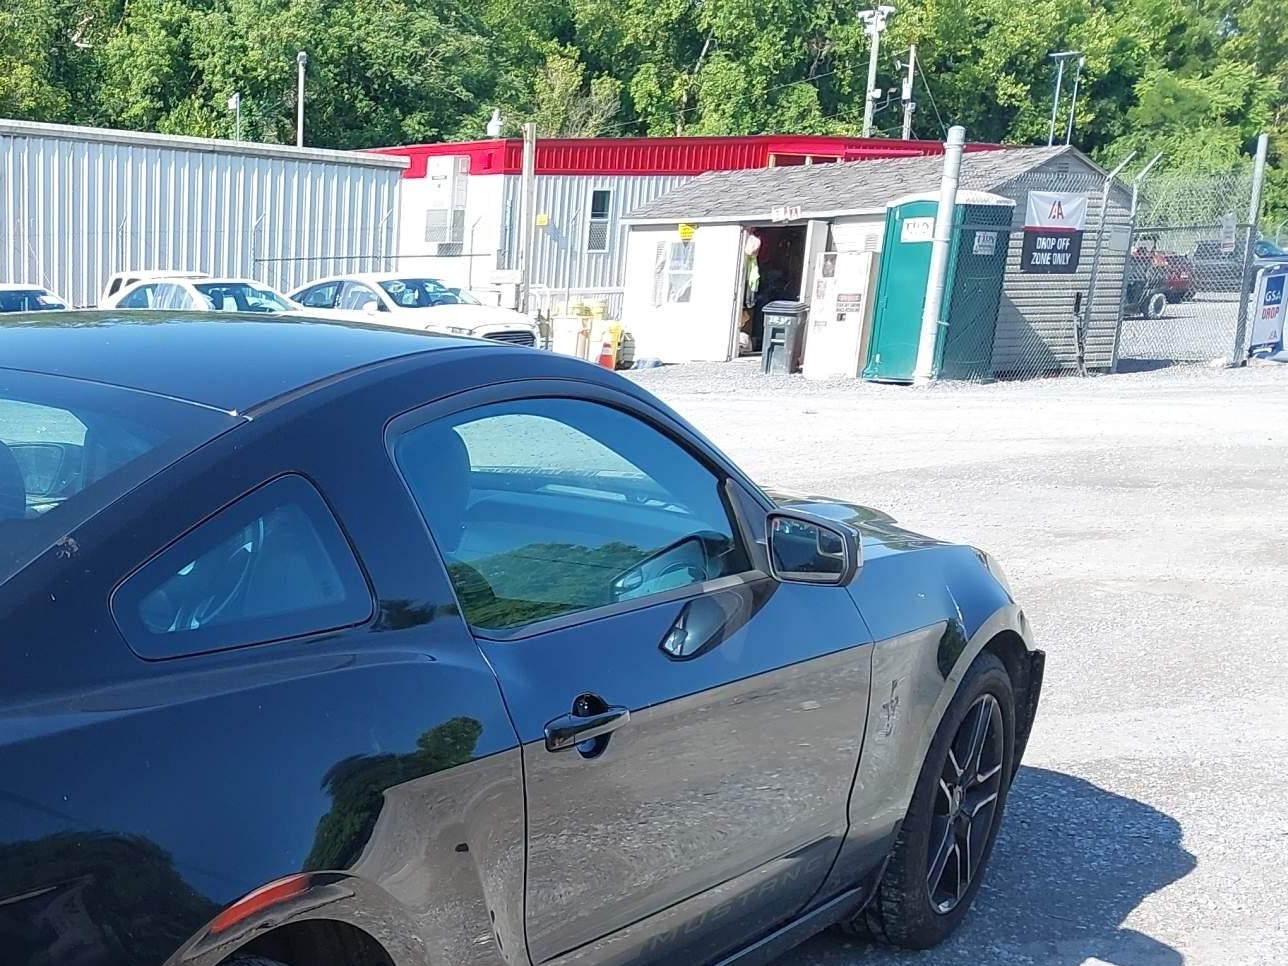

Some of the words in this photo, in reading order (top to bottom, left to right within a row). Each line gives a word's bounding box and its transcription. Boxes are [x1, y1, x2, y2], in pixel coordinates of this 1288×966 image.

[1036, 237, 1056, 250] DROP
[1056, 238, 1070, 251] OFF
[1030, 252, 1051, 265] ZONE
[1052, 252, 1072, 265] ONLY
[1266, 291, 1282, 302] GSA
[1261, 306, 1280, 320] DROP
